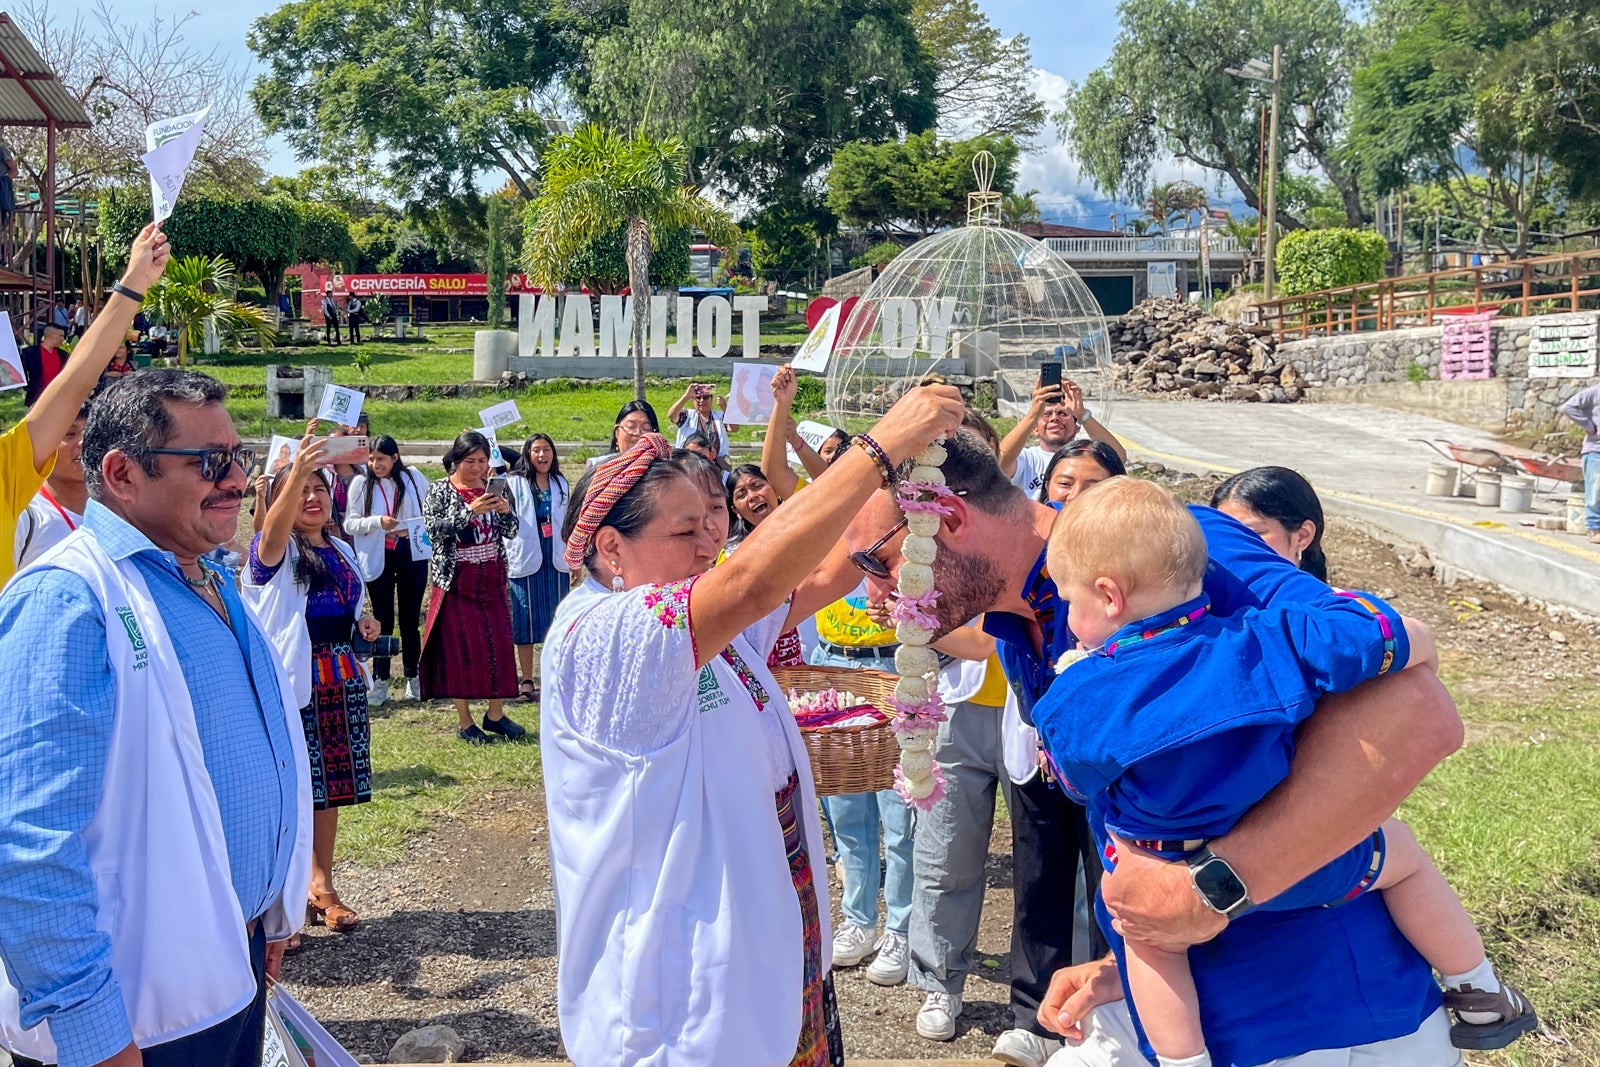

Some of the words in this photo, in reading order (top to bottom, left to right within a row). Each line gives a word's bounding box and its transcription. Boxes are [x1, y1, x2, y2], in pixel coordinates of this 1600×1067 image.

[350, 276, 427, 290] CERVECERÍA
[429, 278, 466, 290] SALOJ
[827, 609, 888, 637] GUATEMAL
